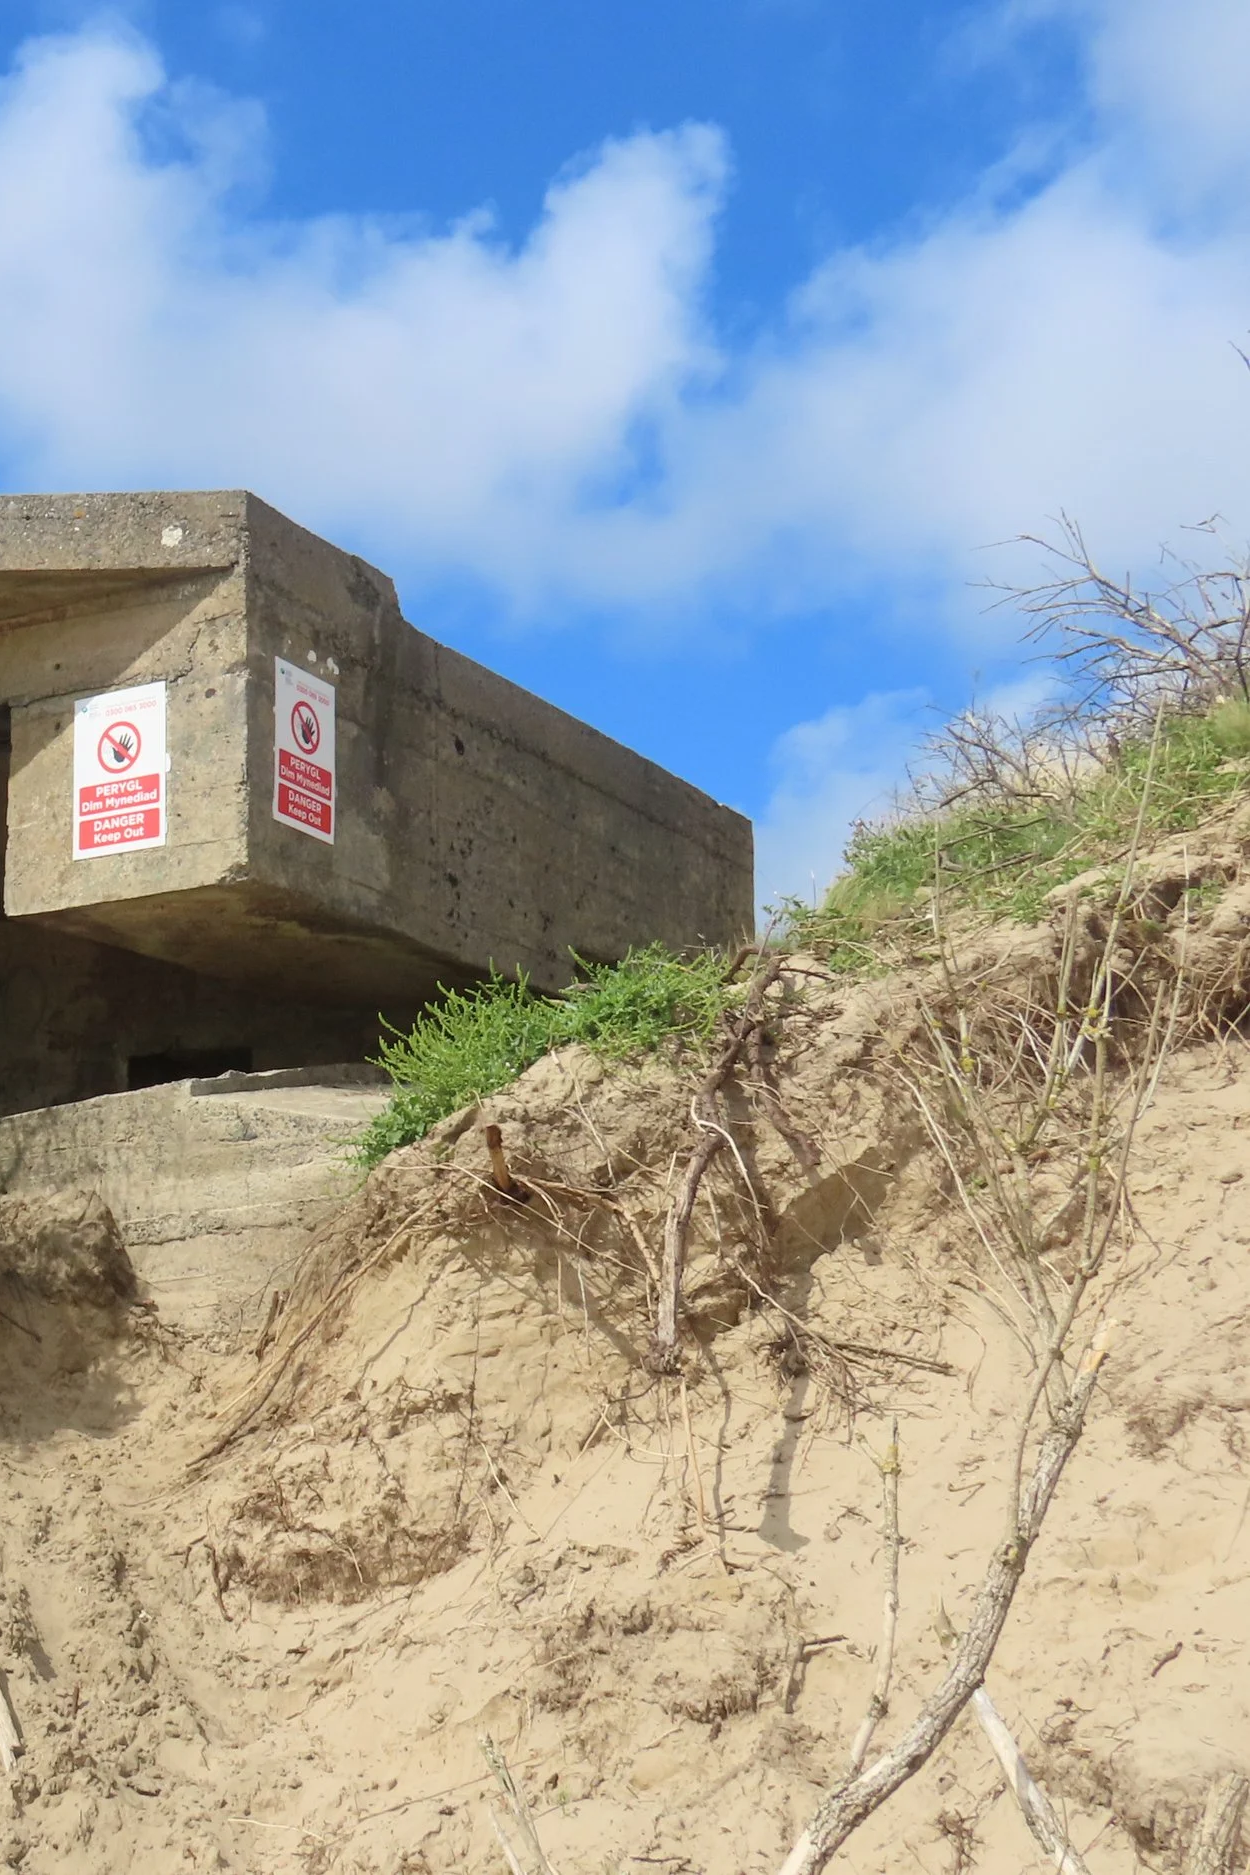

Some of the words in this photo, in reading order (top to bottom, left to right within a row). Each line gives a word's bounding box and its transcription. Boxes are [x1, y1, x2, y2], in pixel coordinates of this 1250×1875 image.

[290, 756, 321, 780] PERYGL
[96, 779, 142, 797] PERYGL
[280, 765, 295, 780] Dim
[296, 773, 330, 796] Mynediad
[81, 800, 103, 812] Dim
[105, 789, 157, 808] Mynediad
[288, 790, 322, 814] DANGER
[93, 813, 145, 832] DANGER
[288, 803, 307, 820] Keep
[308, 812, 322, 826] Out
[93, 832, 121, 844] Keep
[123, 826, 145, 838] Out
